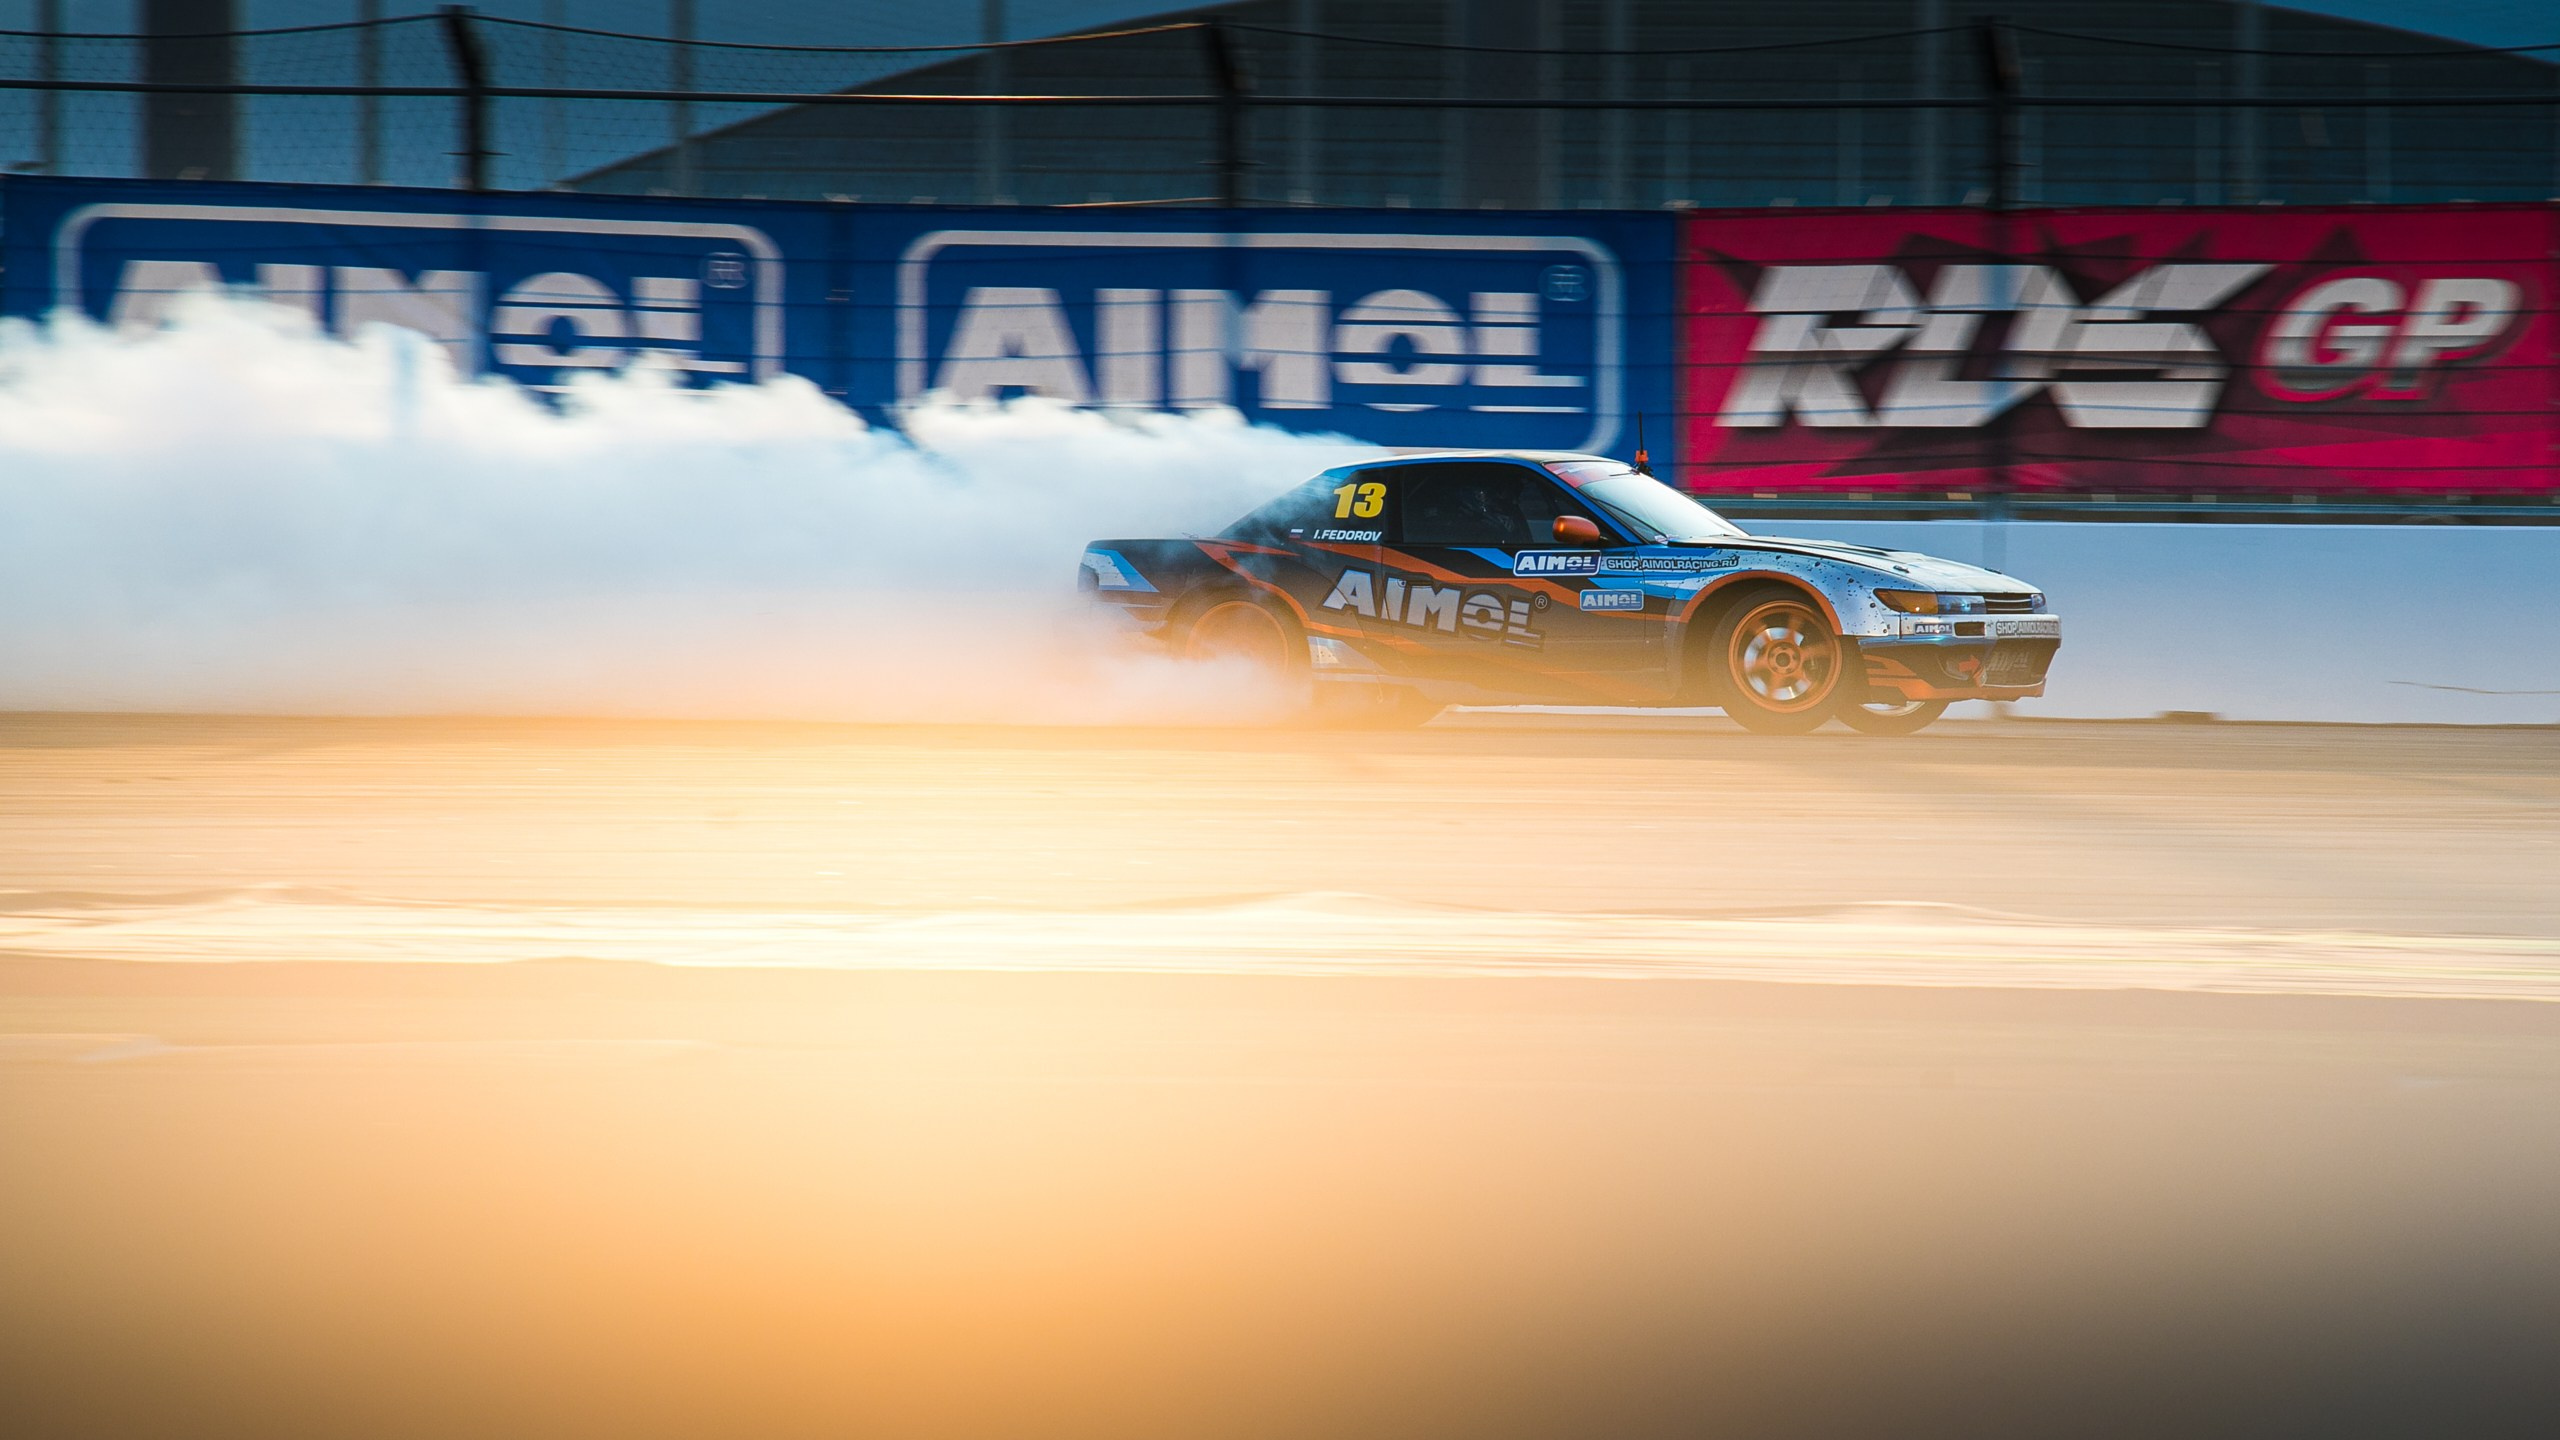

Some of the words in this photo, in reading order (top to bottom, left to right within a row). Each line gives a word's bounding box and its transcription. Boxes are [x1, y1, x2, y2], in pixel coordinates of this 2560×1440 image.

[930, 286, 1588, 413] AIMOL
[1714, 264, 2278, 428] RDS
[2264, 277, 2522, 400] GP
[1333, 482, 1387, 519] 13
[1313, 529, 1382, 542] I.FEDOROV
[1516, 555, 1597, 571] AIMOL
[1607, 558, 1738, 570] SHOP.AIMOLRACING.RU
[1322, 568, 1543, 649] AIMOL
[1582, 593, 1641, 608] AIMOL
[1915, 623, 1952, 634] AIMOL
